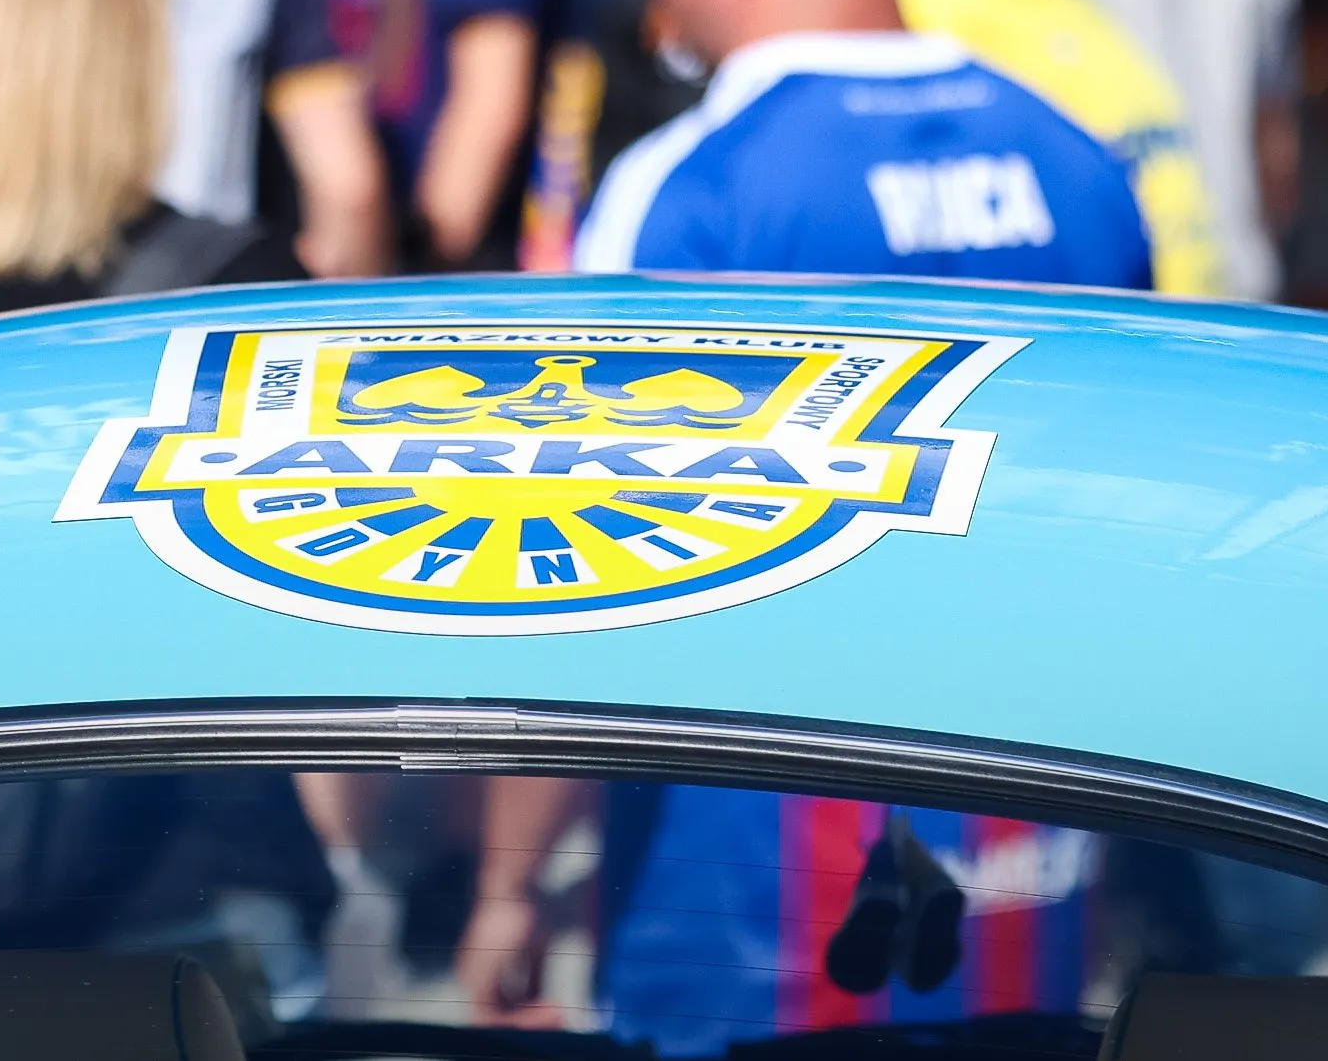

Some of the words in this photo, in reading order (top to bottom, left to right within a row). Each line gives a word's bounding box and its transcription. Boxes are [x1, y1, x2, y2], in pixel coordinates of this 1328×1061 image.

[318, 334, 676, 344] ZWIĄZKOWY
[692, 337, 846, 350] KLUB
[256, 359, 304, 412] MORSKI
[785, 356, 886, 431] SPORTOWY
[234, 440, 811, 484] ARKA
[252, 493, 787, 585] GDYNIA
